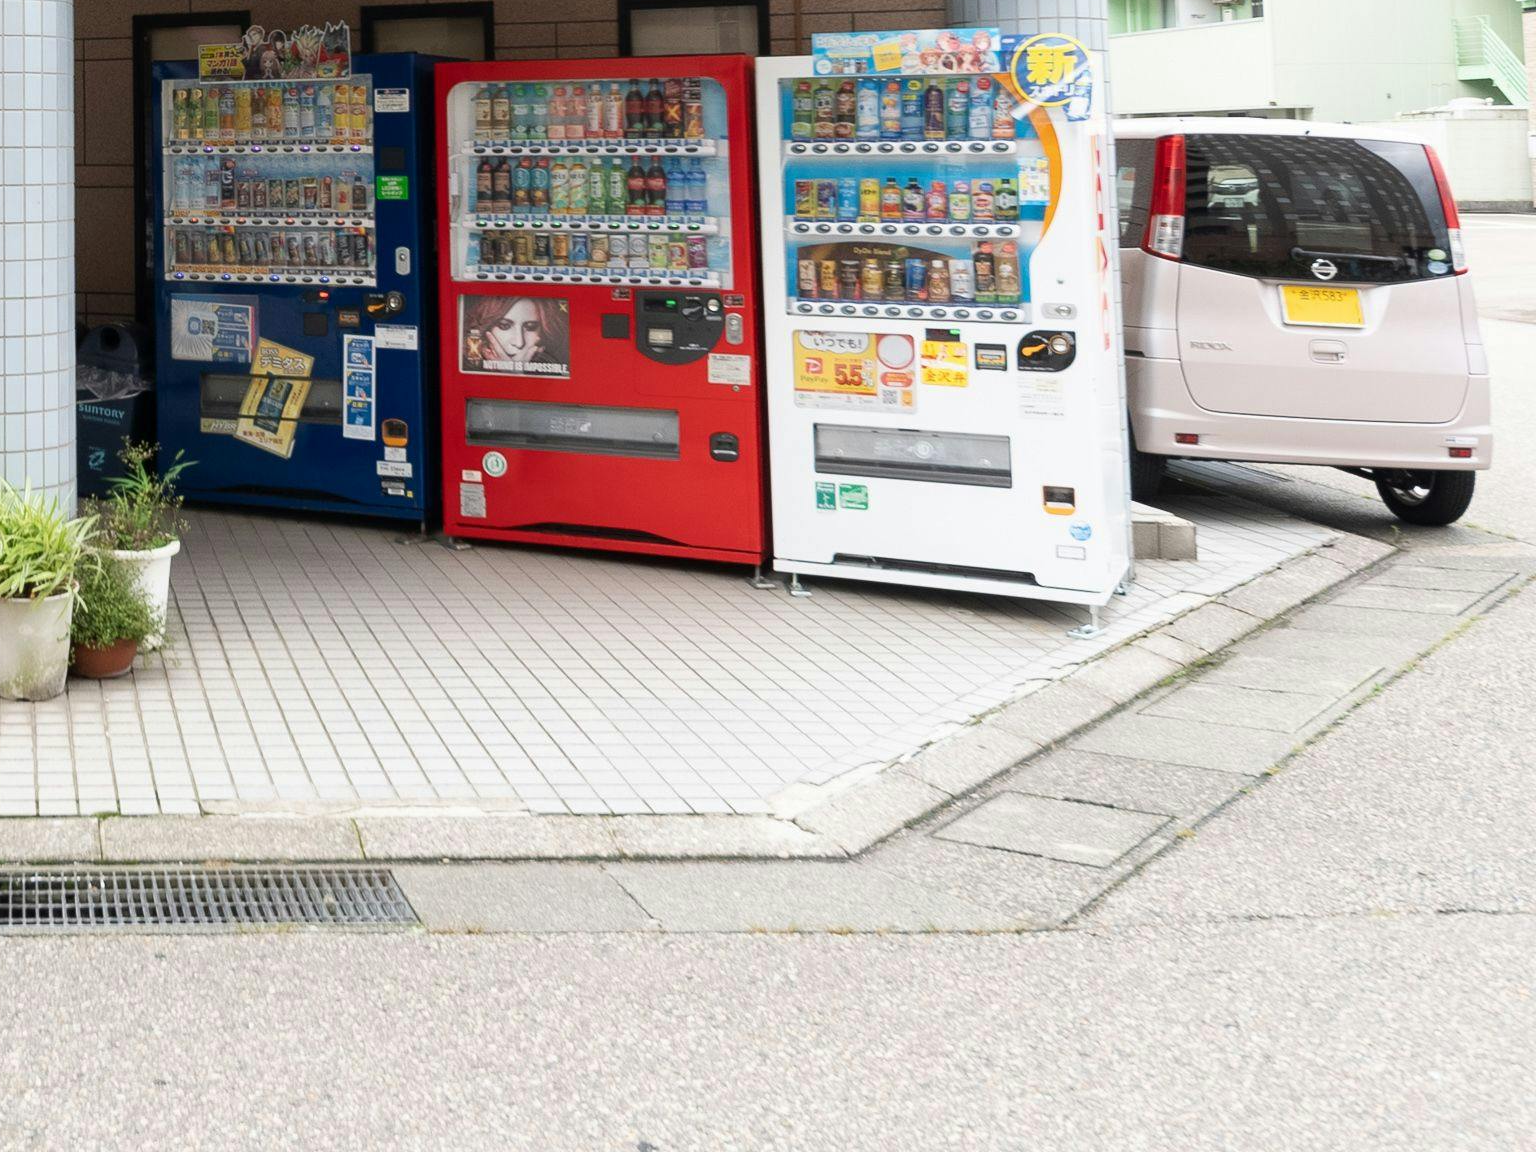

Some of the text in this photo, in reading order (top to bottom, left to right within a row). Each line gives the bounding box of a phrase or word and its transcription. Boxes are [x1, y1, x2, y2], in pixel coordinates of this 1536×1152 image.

[1026, 43, 1078, 85] 新
[813, 336, 863, 349] いつでも!
[260, 355, 306, 370] デミタス
[515, 361, 524, 372] IS
[78, 403, 125, 421] SUNTORY
